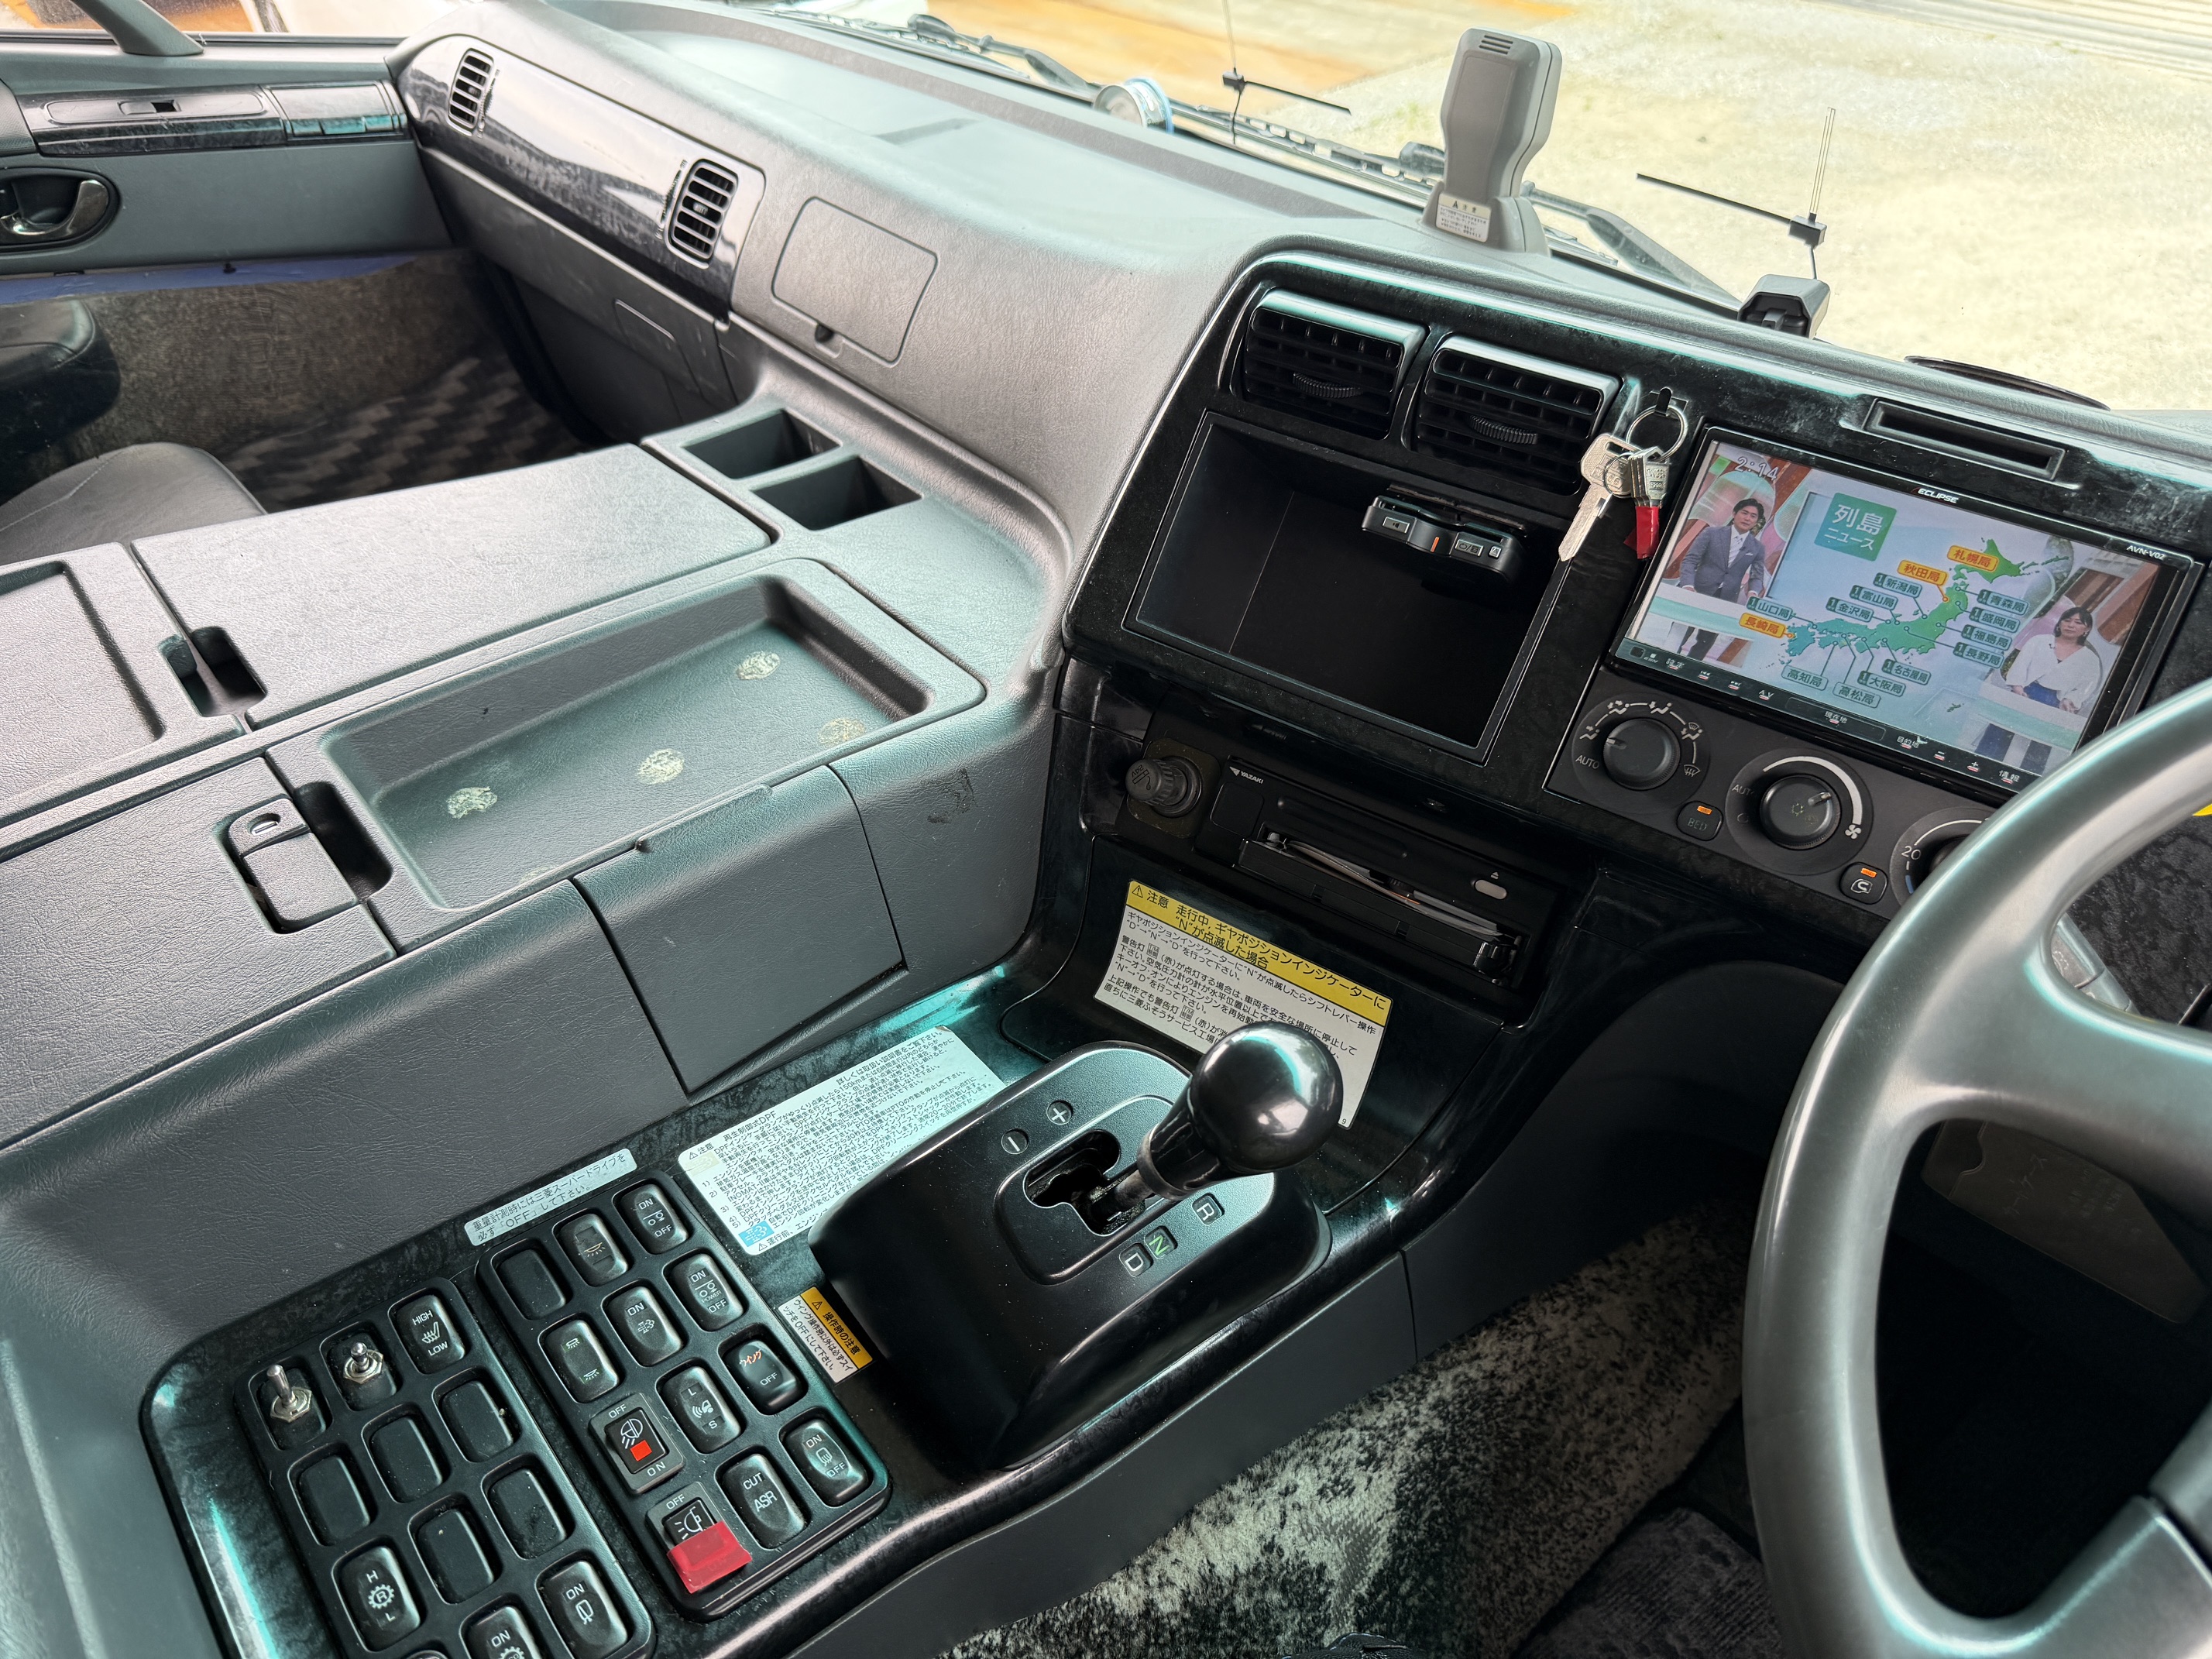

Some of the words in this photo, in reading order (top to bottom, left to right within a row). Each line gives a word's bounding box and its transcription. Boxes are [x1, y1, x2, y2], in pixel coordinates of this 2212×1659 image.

[1734, 455, 1779, 481] 2:14
[1917, 487, 1959, 504] ECLIPSE
[1831, 503, 1884, 536] 列島
[1824, 527, 1874, 551] ニュース
[1953, 549, 1991, 568] 札幌局
[2126, 544, 2166, 561] AVN-V02
[1903, 562, 1941, 582] 秋田局
[1884, 578, 1918, 596] 新潟局
[1861, 590, 1895, 607] 富山局
[1990, 595, 2025, 613] 青森局
[1757, 602, 1791, 618] 山口局
[1837, 603, 1870, 620] 金沢局
[1744, 617, 1780, 635] 長崎局
[1982, 613, 2017, 630] 盛岡局
[1973, 630, 2008, 648] 福島局
[1965, 647, 2001, 666] 長野局
[1787, 668, 1823, 688] 高知局
[1894, 665, 1929, 682] 名古屋局
[1869, 676, 1903, 694] 大阪局
[1838, 685, 1875, 706] 高松局
[1824, 710, 1848, 724] 現在地
[1897, 735, 1920, 749] 目的地
[1575, 754, 1600, 770] AUTO
[1240, 770, 1264, 785] YAZAKI
[1998, 769, 2020, 783] 情報
[1687, 817, 1707, 831] BED
[1901, 845, 1922, 861] 20
[1146, 890, 1170, 909] 注意
[696, 1142, 714, 1155] 注意
[722, 1110, 778, 1142] 再生制御式DPF
[638, 1197, 654, 1210] ON
[1197, 1203, 1215, 1221] R
[654, 1224, 672, 1237] OFF
[1149, 1235, 1170, 1256] N
[1125, 1252, 1144, 1272] D
[691, 1269, 706, 1283] ON
[701, 1290, 723, 1304] POWER
[627, 1302, 644, 1316] ON
[709, 1299, 727, 1314] OFF
[411, 1310, 434, 1326] HIGH
[823, 1311, 861, 1355] 操作時の注意
[428, 1340, 448, 1357] LOW
[760, 1372, 778, 1386] OFF
[688, 1387, 697, 1396] L
[608, 1403, 627, 1419] OFF
[709, 1420, 718, 1430] S
[806, 1434, 823, 1448] ON
[647, 1462, 666, 1477] ON
[826, 1462, 846, 1478] OFF
[743, 1472, 763, 1490] CUT
[666, 1494, 685, 1510] OFF
[754, 1491, 777, 1512] ASR
[366, 1569, 379, 1582] H
[376, 1592, 386, 1602] R
[565, 1582, 586, 1601] ON
[385, 1612, 396, 1623] L
[491, 1629, 511, 1649] ON
